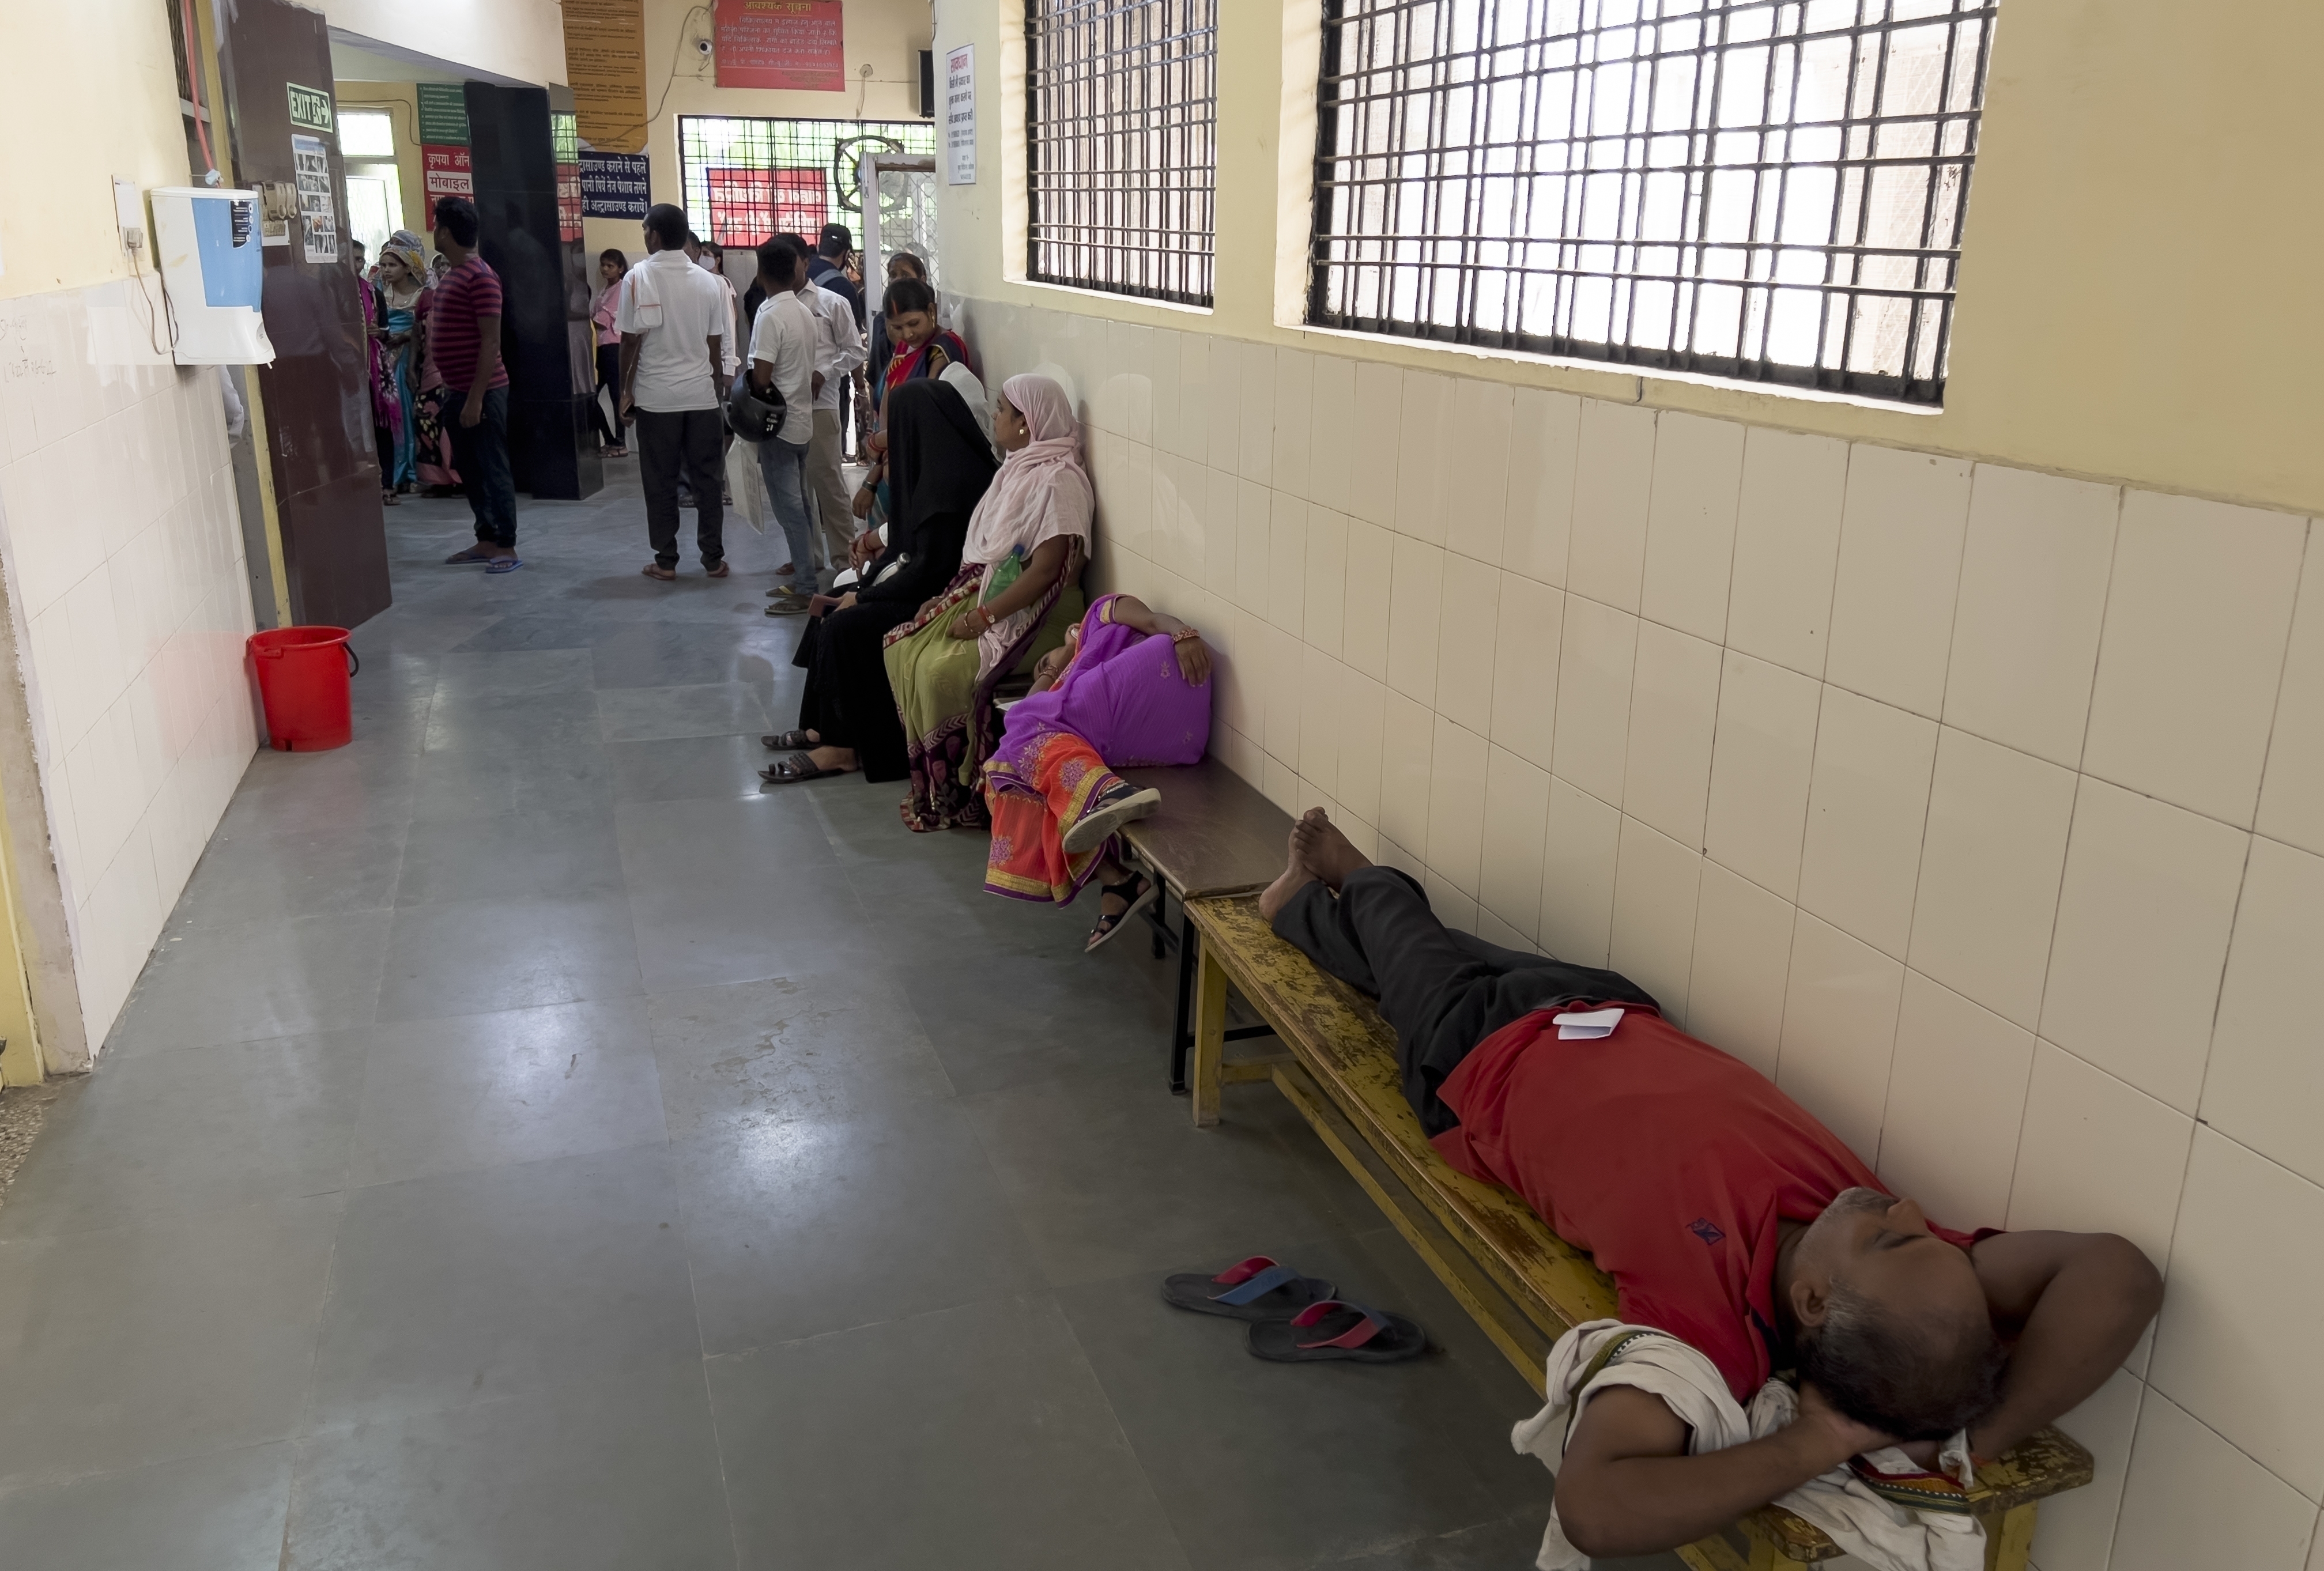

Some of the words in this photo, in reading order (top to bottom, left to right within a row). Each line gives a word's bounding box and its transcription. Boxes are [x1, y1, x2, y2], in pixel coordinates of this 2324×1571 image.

[744, 1, 782, 10] आवश्यक
[787, 2, 812, 14] सूचना
[290, 90, 311, 121] EXIT
[427, 153, 450, 169] कृपया
[606, 156, 623, 173] कराने
[624, 157, 631, 173] से
[632, 157, 646, 175] पहले
[429, 173, 469, 191] मोबाइल
[582, 175, 594, 192] पानी
[607, 176, 617, 193] तेज
[617, 176, 633, 194] पेशाब
[633, 178, 647, 194] लगने
[582, 195, 589, 213] ही
[591, 200, 627, 213] अल्ट्रासाउण्ड
